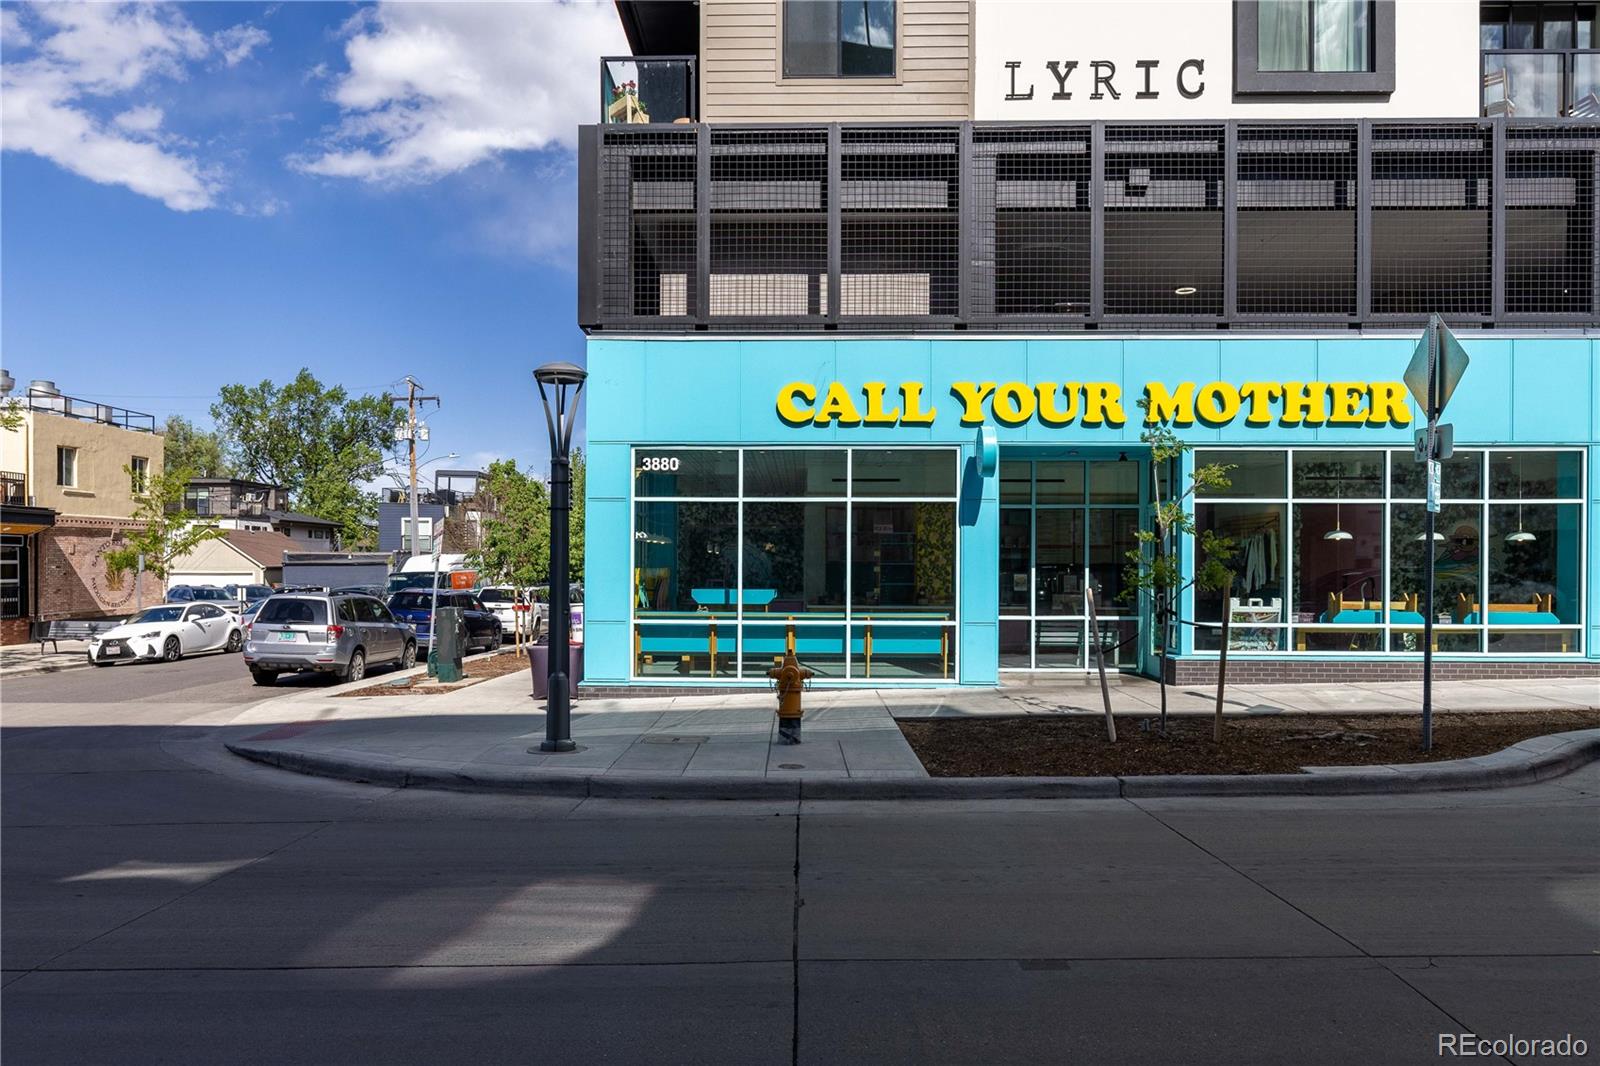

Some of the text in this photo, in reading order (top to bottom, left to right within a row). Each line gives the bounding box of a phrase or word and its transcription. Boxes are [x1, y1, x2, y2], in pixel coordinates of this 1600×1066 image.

[1004, 59, 1205, 101] LYRIC
[777, 382, 1413, 424] CALL YOUR MOTHER
[642, 457, 680, 471] 3880
